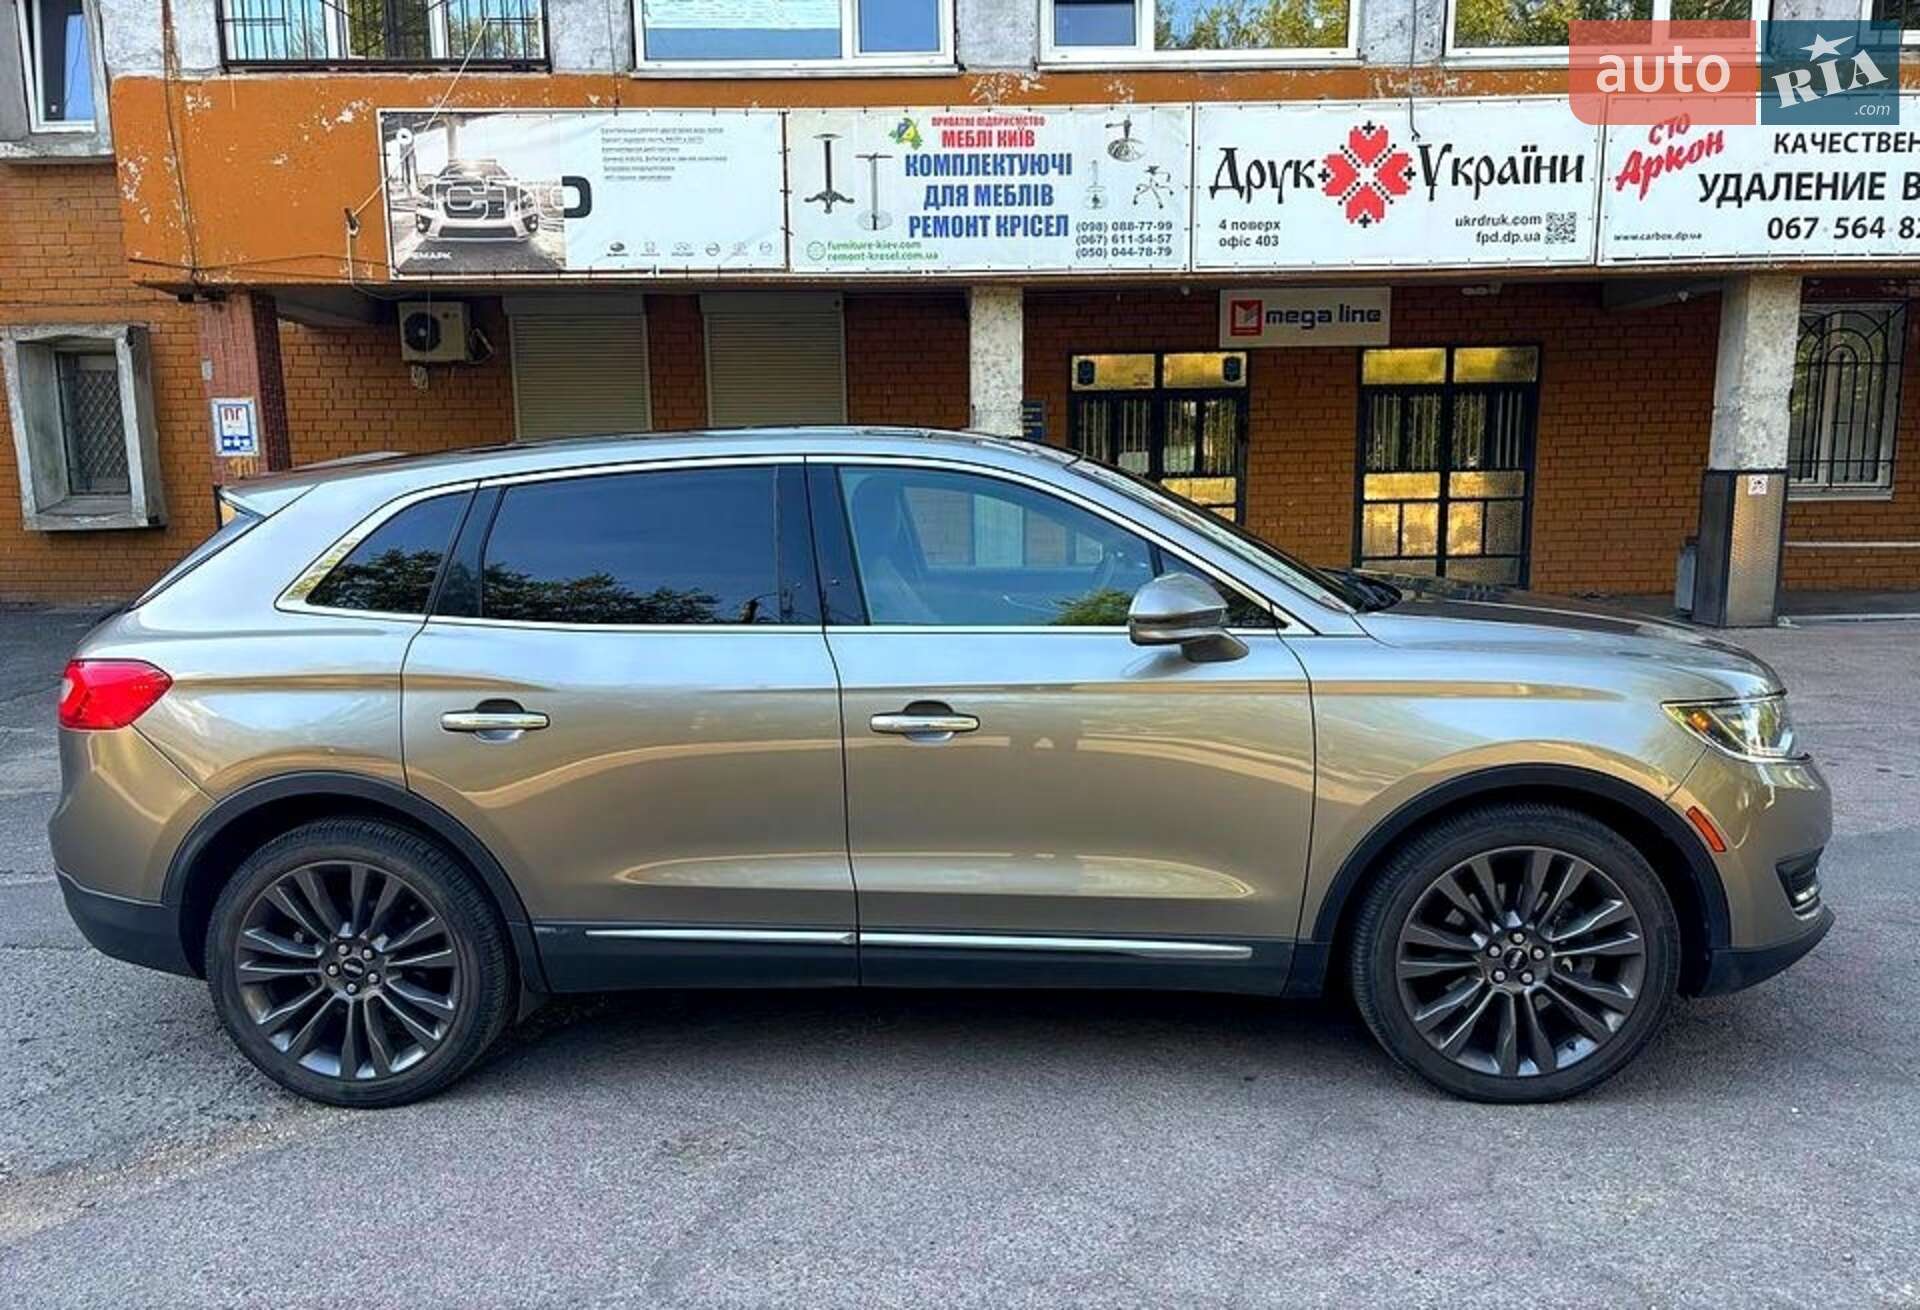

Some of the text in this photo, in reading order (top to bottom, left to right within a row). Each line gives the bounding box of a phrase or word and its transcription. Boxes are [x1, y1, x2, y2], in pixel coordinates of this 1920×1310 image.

[942, 127, 1036, 148] МЕБЛІ КИЇВ
[905, 153, 1073, 177] КОМПЛЕКТУЮЧІ
[1209, 143, 1585, 204] Друк України
[1615, 129, 1724, 201] Аркон
[923, 184, 1055, 211] ДЛЯ МЕБЛІВ
[1698, 171, 1887, 208] УДАЛЕНИЕ
[909, 214, 1070, 238] РЕМОНТ КРІСЕЛ
[1219, 219, 1281, 232] 4 поверх
[1455, 213, 1543, 227] ukrdruk.com
[1767, 216, 1819, 240] 067
[1833, 216, 1885, 239] 564
[1111, 233, 1173, 244] 611-54-57
[1219, 235, 1279, 250] офіс 403
[1476, 231, 1541, 246] fpd.dp.ua
[1266, 303, 1380, 330] mega line
